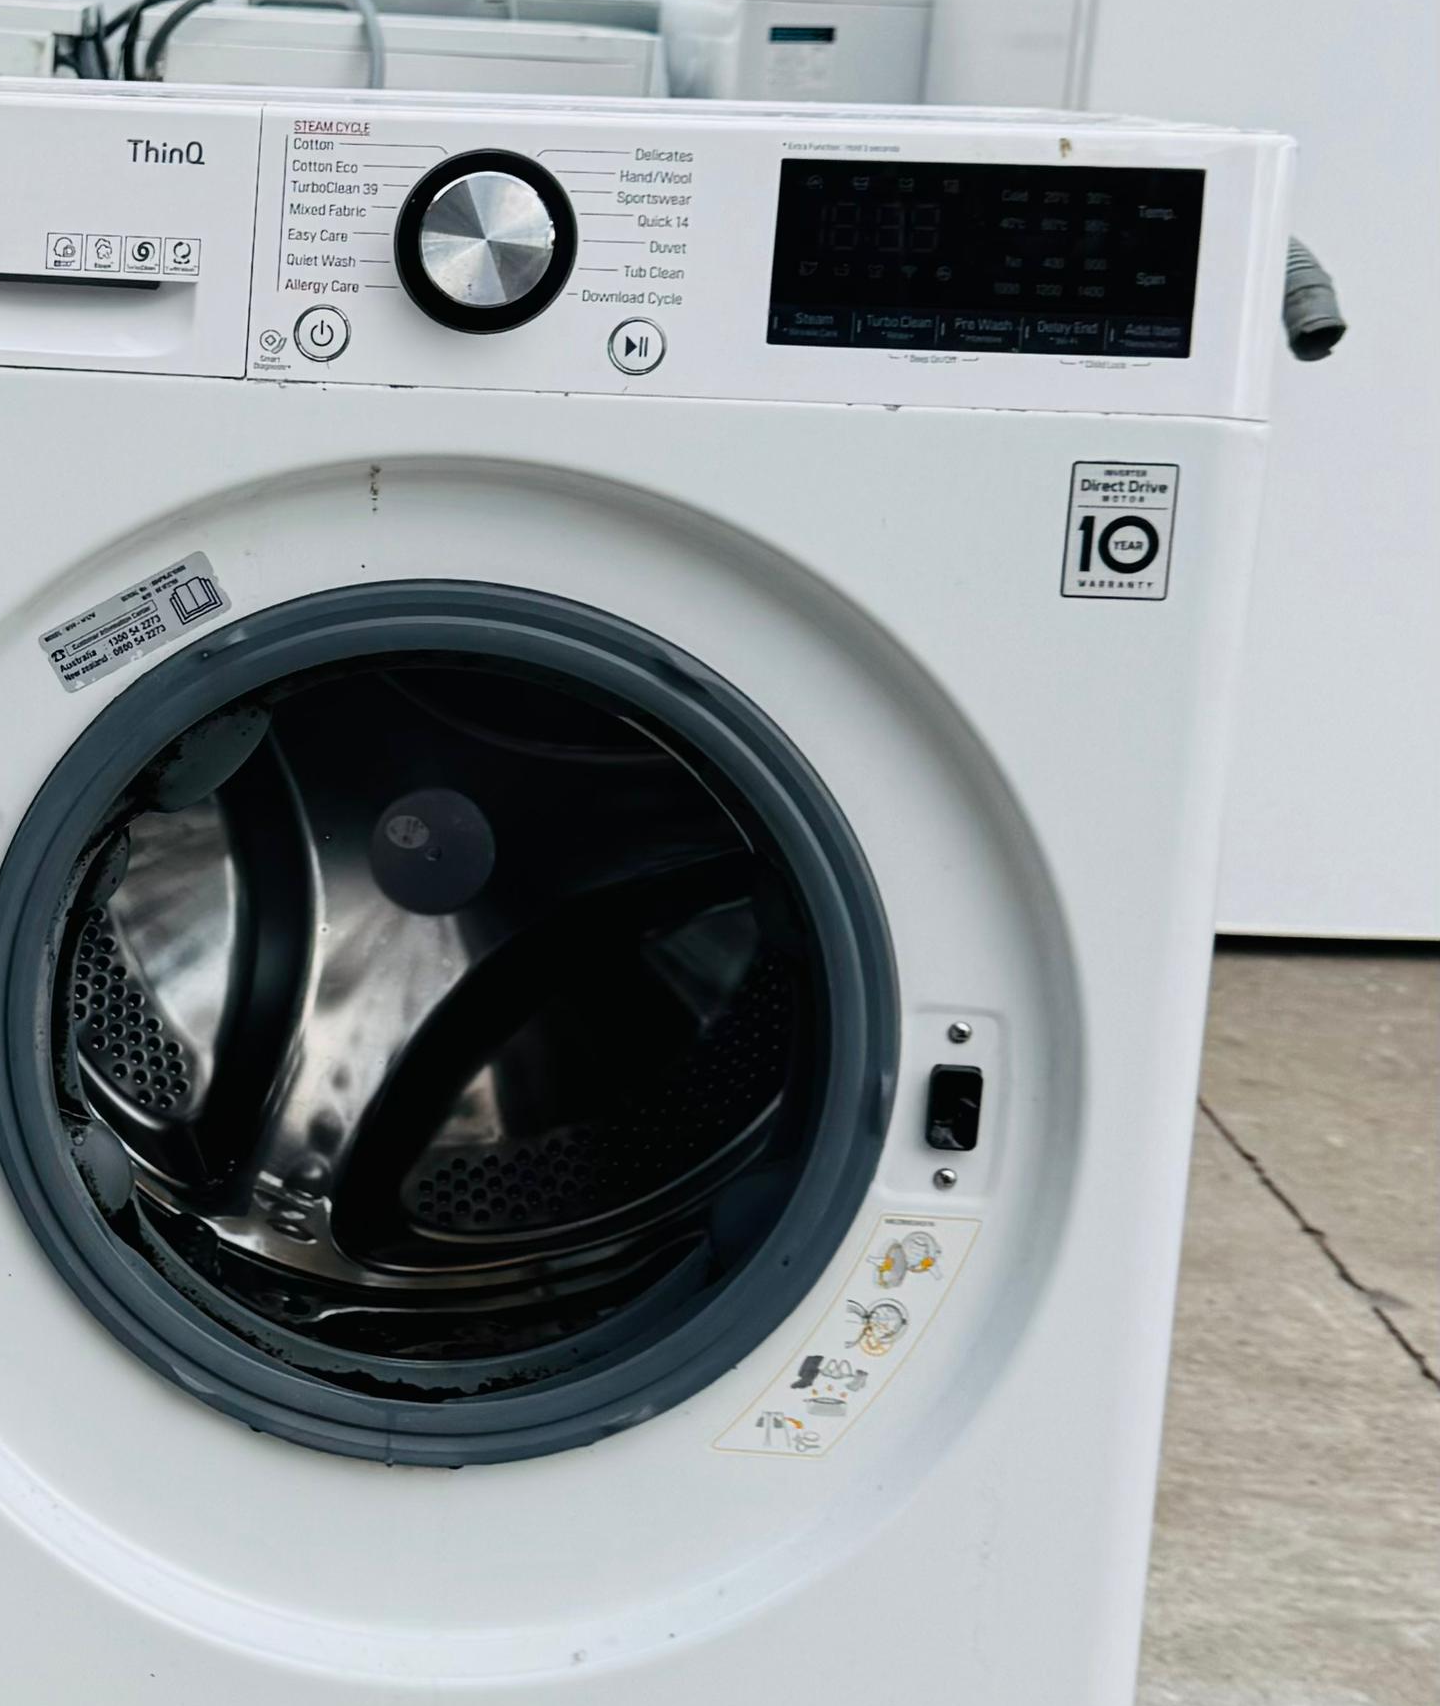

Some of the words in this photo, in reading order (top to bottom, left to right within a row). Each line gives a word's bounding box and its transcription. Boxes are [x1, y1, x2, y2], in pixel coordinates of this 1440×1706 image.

[294, 120, 333, 134] STEAM
[335, 121, 371, 136] CYCLE
[293, 137, 334, 151] Cotton
[127, 139, 206, 166] ThinQ
[635, 148, 693, 163] Delicates
[292, 159, 331, 173] Cotton
[334, 161, 358, 174] Eco
[620, 169, 692, 186] Hand/Wool
[291, 180, 360, 195] TurboClean
[363, 182, 378, 196] 39
[617, 191, 692, 209] Sportswear
[289, 202, 326, 217] Mixed
[328, 204, 367, 218] Fabric
[638, 214, 671, 229] Quick
[674, 214, 689, 229] 14
[288, 228, 317, 245] Easy
[320, 230, 348, 243] Care
[649, 240, 686, 255] Duvet
[287, 253, 320, 268] Quiet
[323, 255, 356, 269] Wash
[624, 266, 646, 279] Tub
[649, 266, 685, 280] Clean
[285, 278, 328, 295] Allergy
[330, 280, 359, 293] Care
[582, 289, 644, 304] Download
[647, 292, 682, 307] Cycle
[795, 311, 834, 327] Steam
[866, 314, 900, 328] Turbo
[978, 318, 1013, 332] Wash
[1080, 478, 1125, 492] Direct
[1128, 480, 1168, 494] Drive
[1102, 495, 1145, 503] MOTOR
[1078, 515, 1159, 574] 10
[1113, 540, 1144, 551] YEAR
[1078, 579, 1154, 589] WARRANTY
[60, 649, 97, 672] Australia
[108, 631, 128, 647] 1300
[128, 626, 140, 636] 54
[140, 614, 161, 631] 2273
[64, 670, 80, 681] New
[134, 635, 145, 645] 54
[145, 624, 166, 640] 2273
